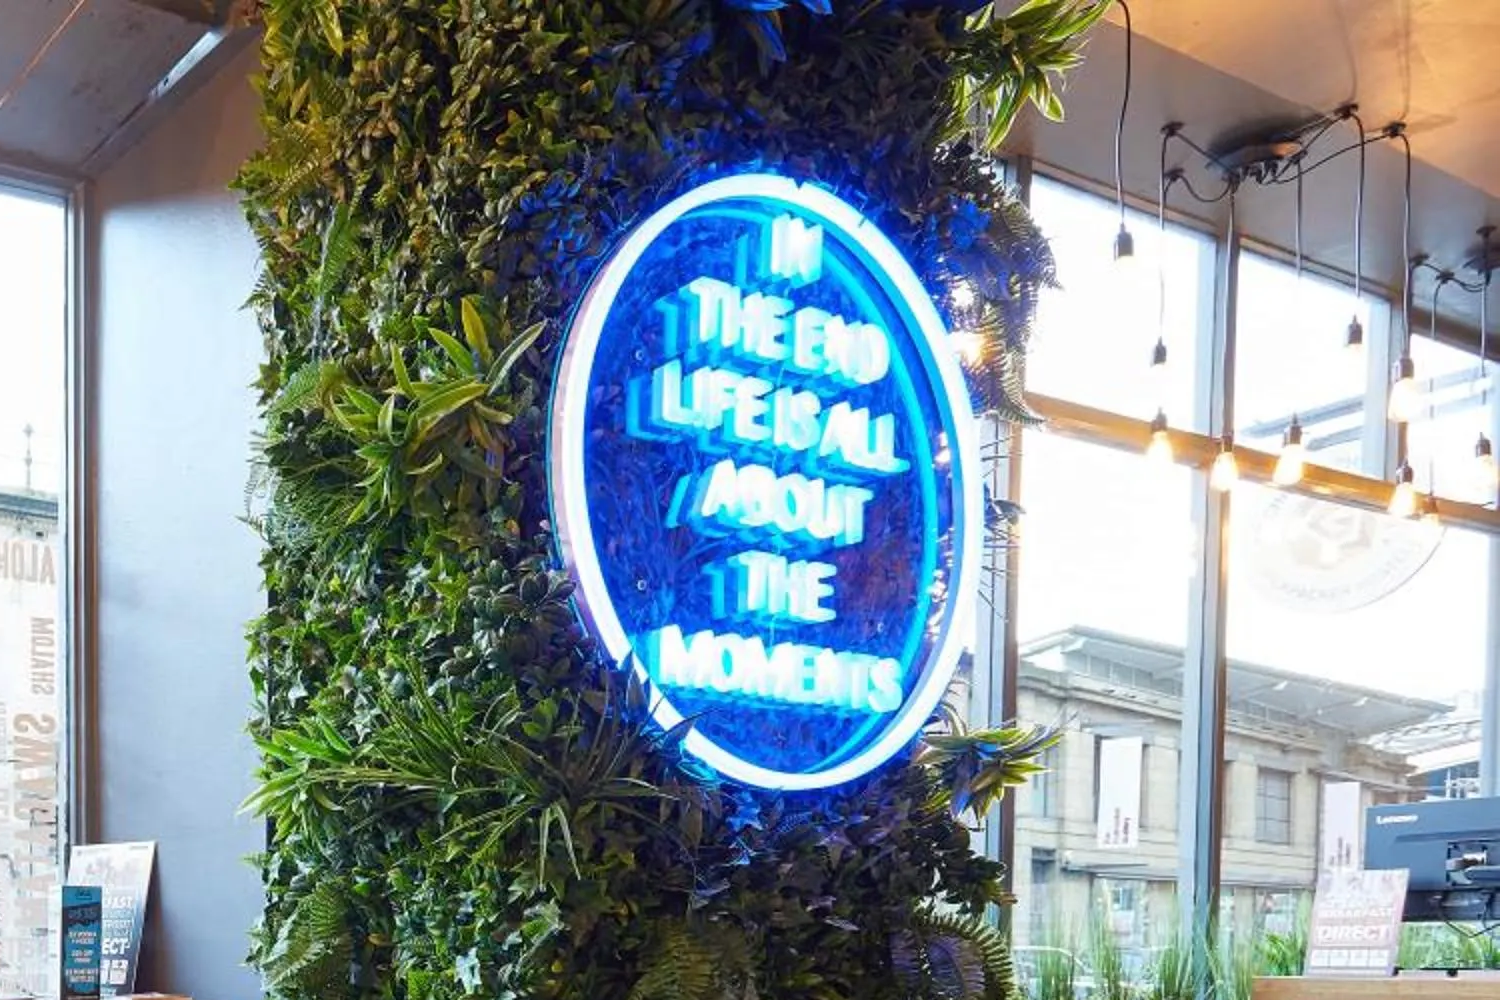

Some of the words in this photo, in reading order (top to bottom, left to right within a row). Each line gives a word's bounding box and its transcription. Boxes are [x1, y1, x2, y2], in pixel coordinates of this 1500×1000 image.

[768, 210, 824, 283] IN
[682, 274, 795, 364] THE
[792, 303, 892, 387] END
[650, 359, 773, 446] LIFE
[772, 385, 822, 452] IS
[818, 400, 910, 474] ALL
[696, 457, 875, 547] ABOUT
[736, 550, 837, 624] THE
[648, 622, 904, 714] MOMENTS
